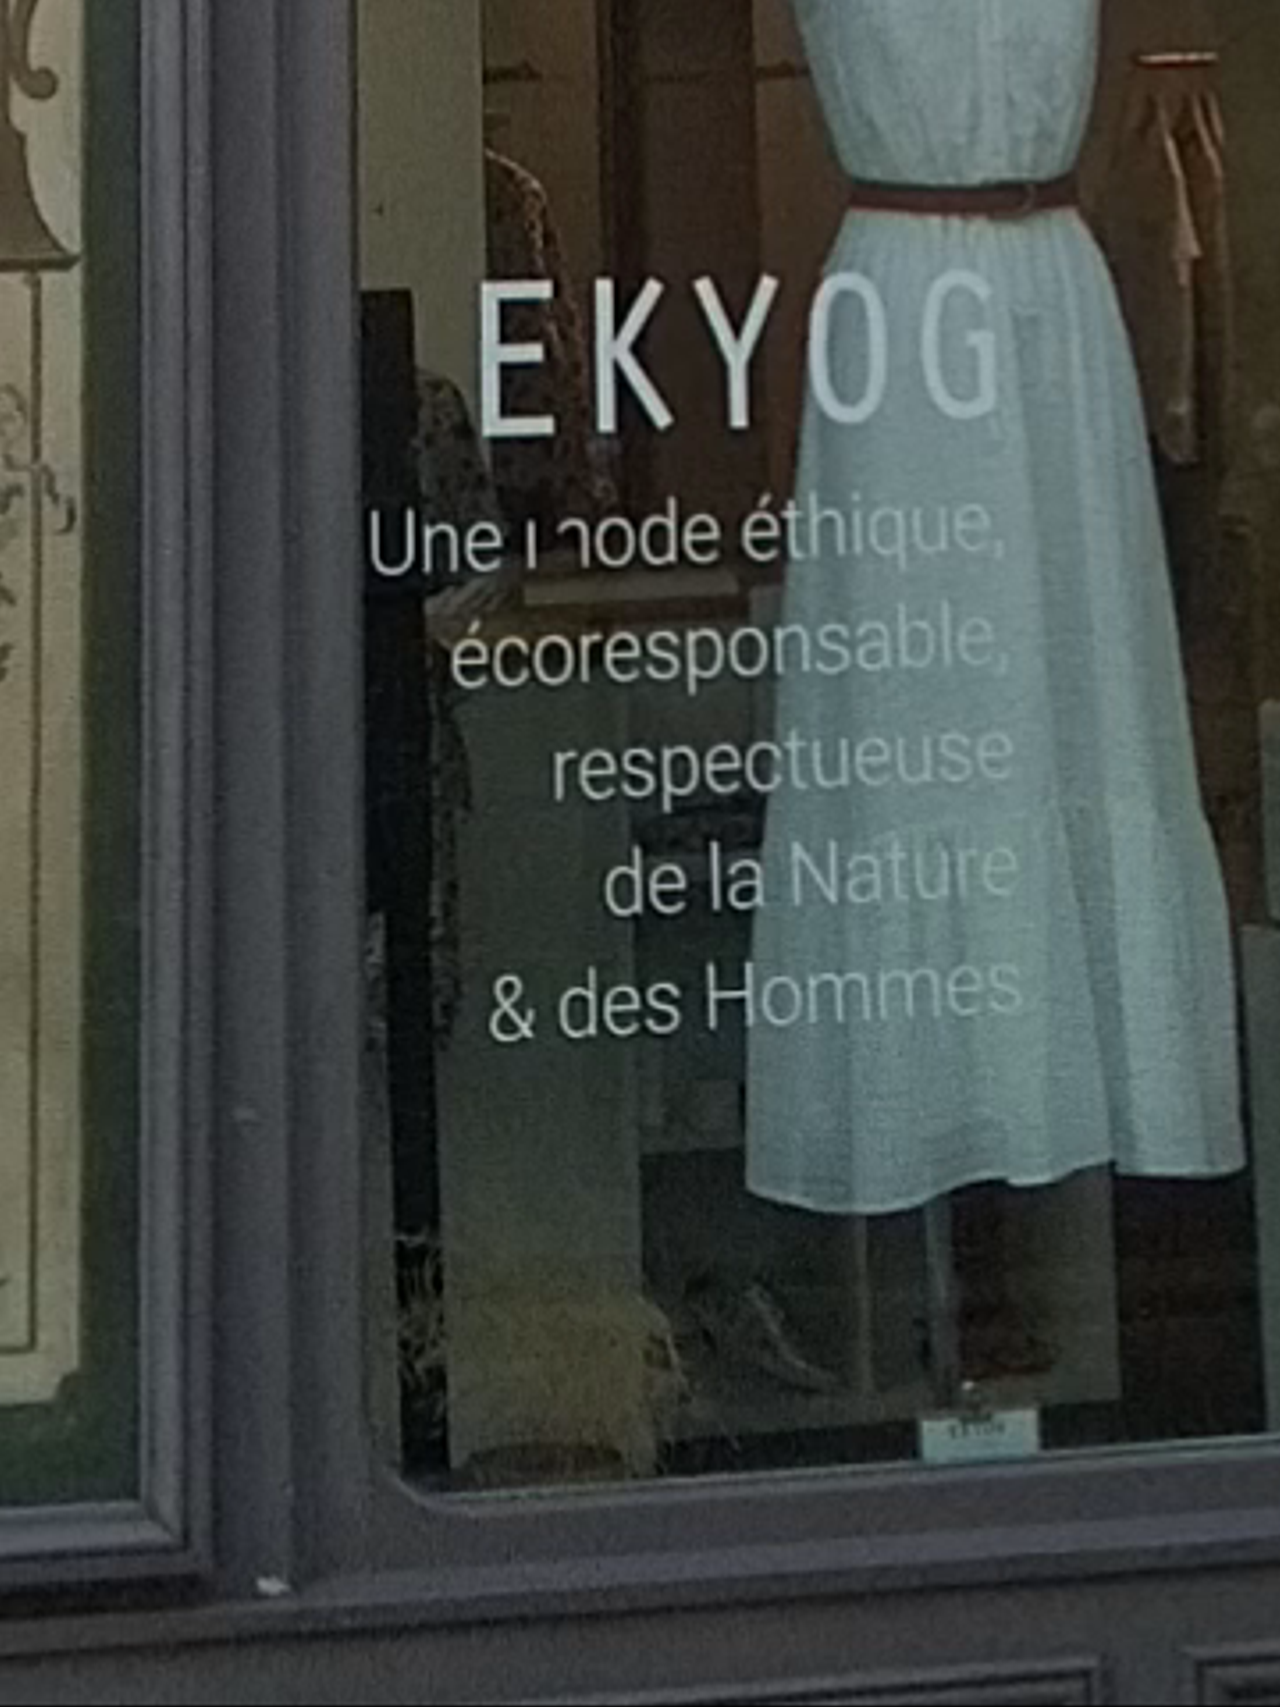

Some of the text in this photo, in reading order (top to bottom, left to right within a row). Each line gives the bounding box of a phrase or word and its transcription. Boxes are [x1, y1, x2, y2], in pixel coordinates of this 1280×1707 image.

[480, 271, 999, 437] EKYOG
[368, 508, 504, 577] Une
[553, 726, 1014, 811] respectueuse
[604, 837, 1019, 918] de la Nature
[487, 960, 1024, 1043] & des Hommes
